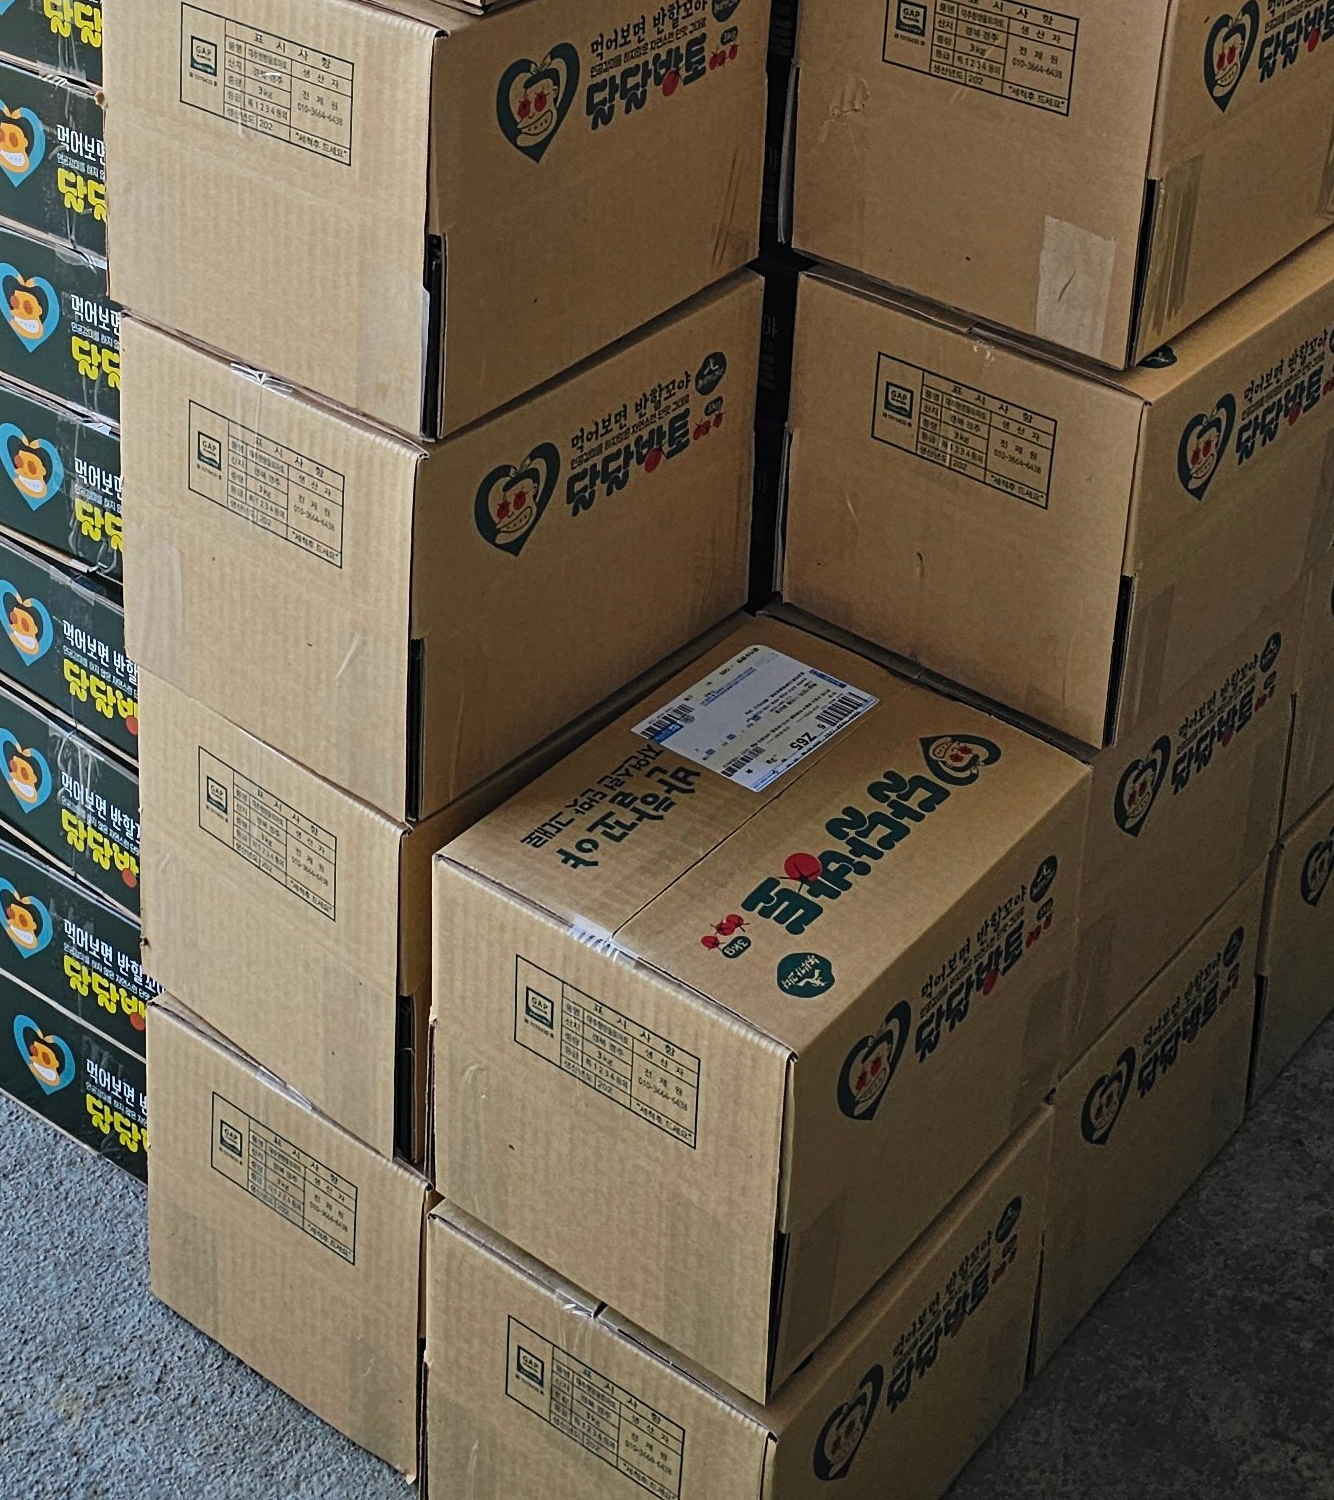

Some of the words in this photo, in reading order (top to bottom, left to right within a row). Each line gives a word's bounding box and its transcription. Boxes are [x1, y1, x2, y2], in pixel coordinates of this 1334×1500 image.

[903, 8, 920, 17] GAP
[938, 18, 953, 29] 산지
[591, 15, 646, 62] 먹어보면
[196, 45, 211, 56] GAP
[1012, 57, 1063, 79] 010-3664-6438
[586, 33, 707, 130] 달달방토
[969, 75, 983, 85] 202
[258, 86, 273, 99] 3kg
[259, 120, 273, 131] 202
[1244, 359, 1284, 403] 먹어보면
[891, 390, 908, 402] GAP
[571, 403, 628, 454] 먹어보면
[634, 370, 691, 414] 반할꼬야
[1236, 365, 1324, 466] 달달방토
[202, 440, 216, 452] GAP
[567, 408, 690, 517] 달달방토
[790, 732, 817, 750] Z65
[557, 767, 700, 869] 반할꼬야
[521, 812, 575, 848] 그대로
[740, 770, 951, 936] 달달방토
[724, 939, 748, 956] 3kg
[921, 938, 971, 999] 먹어보면
[531, 997, 549, 1010] GAP
[87, 1059, 135, 1104] 먹어보면
[597, 1081, 613, 1094] 202
